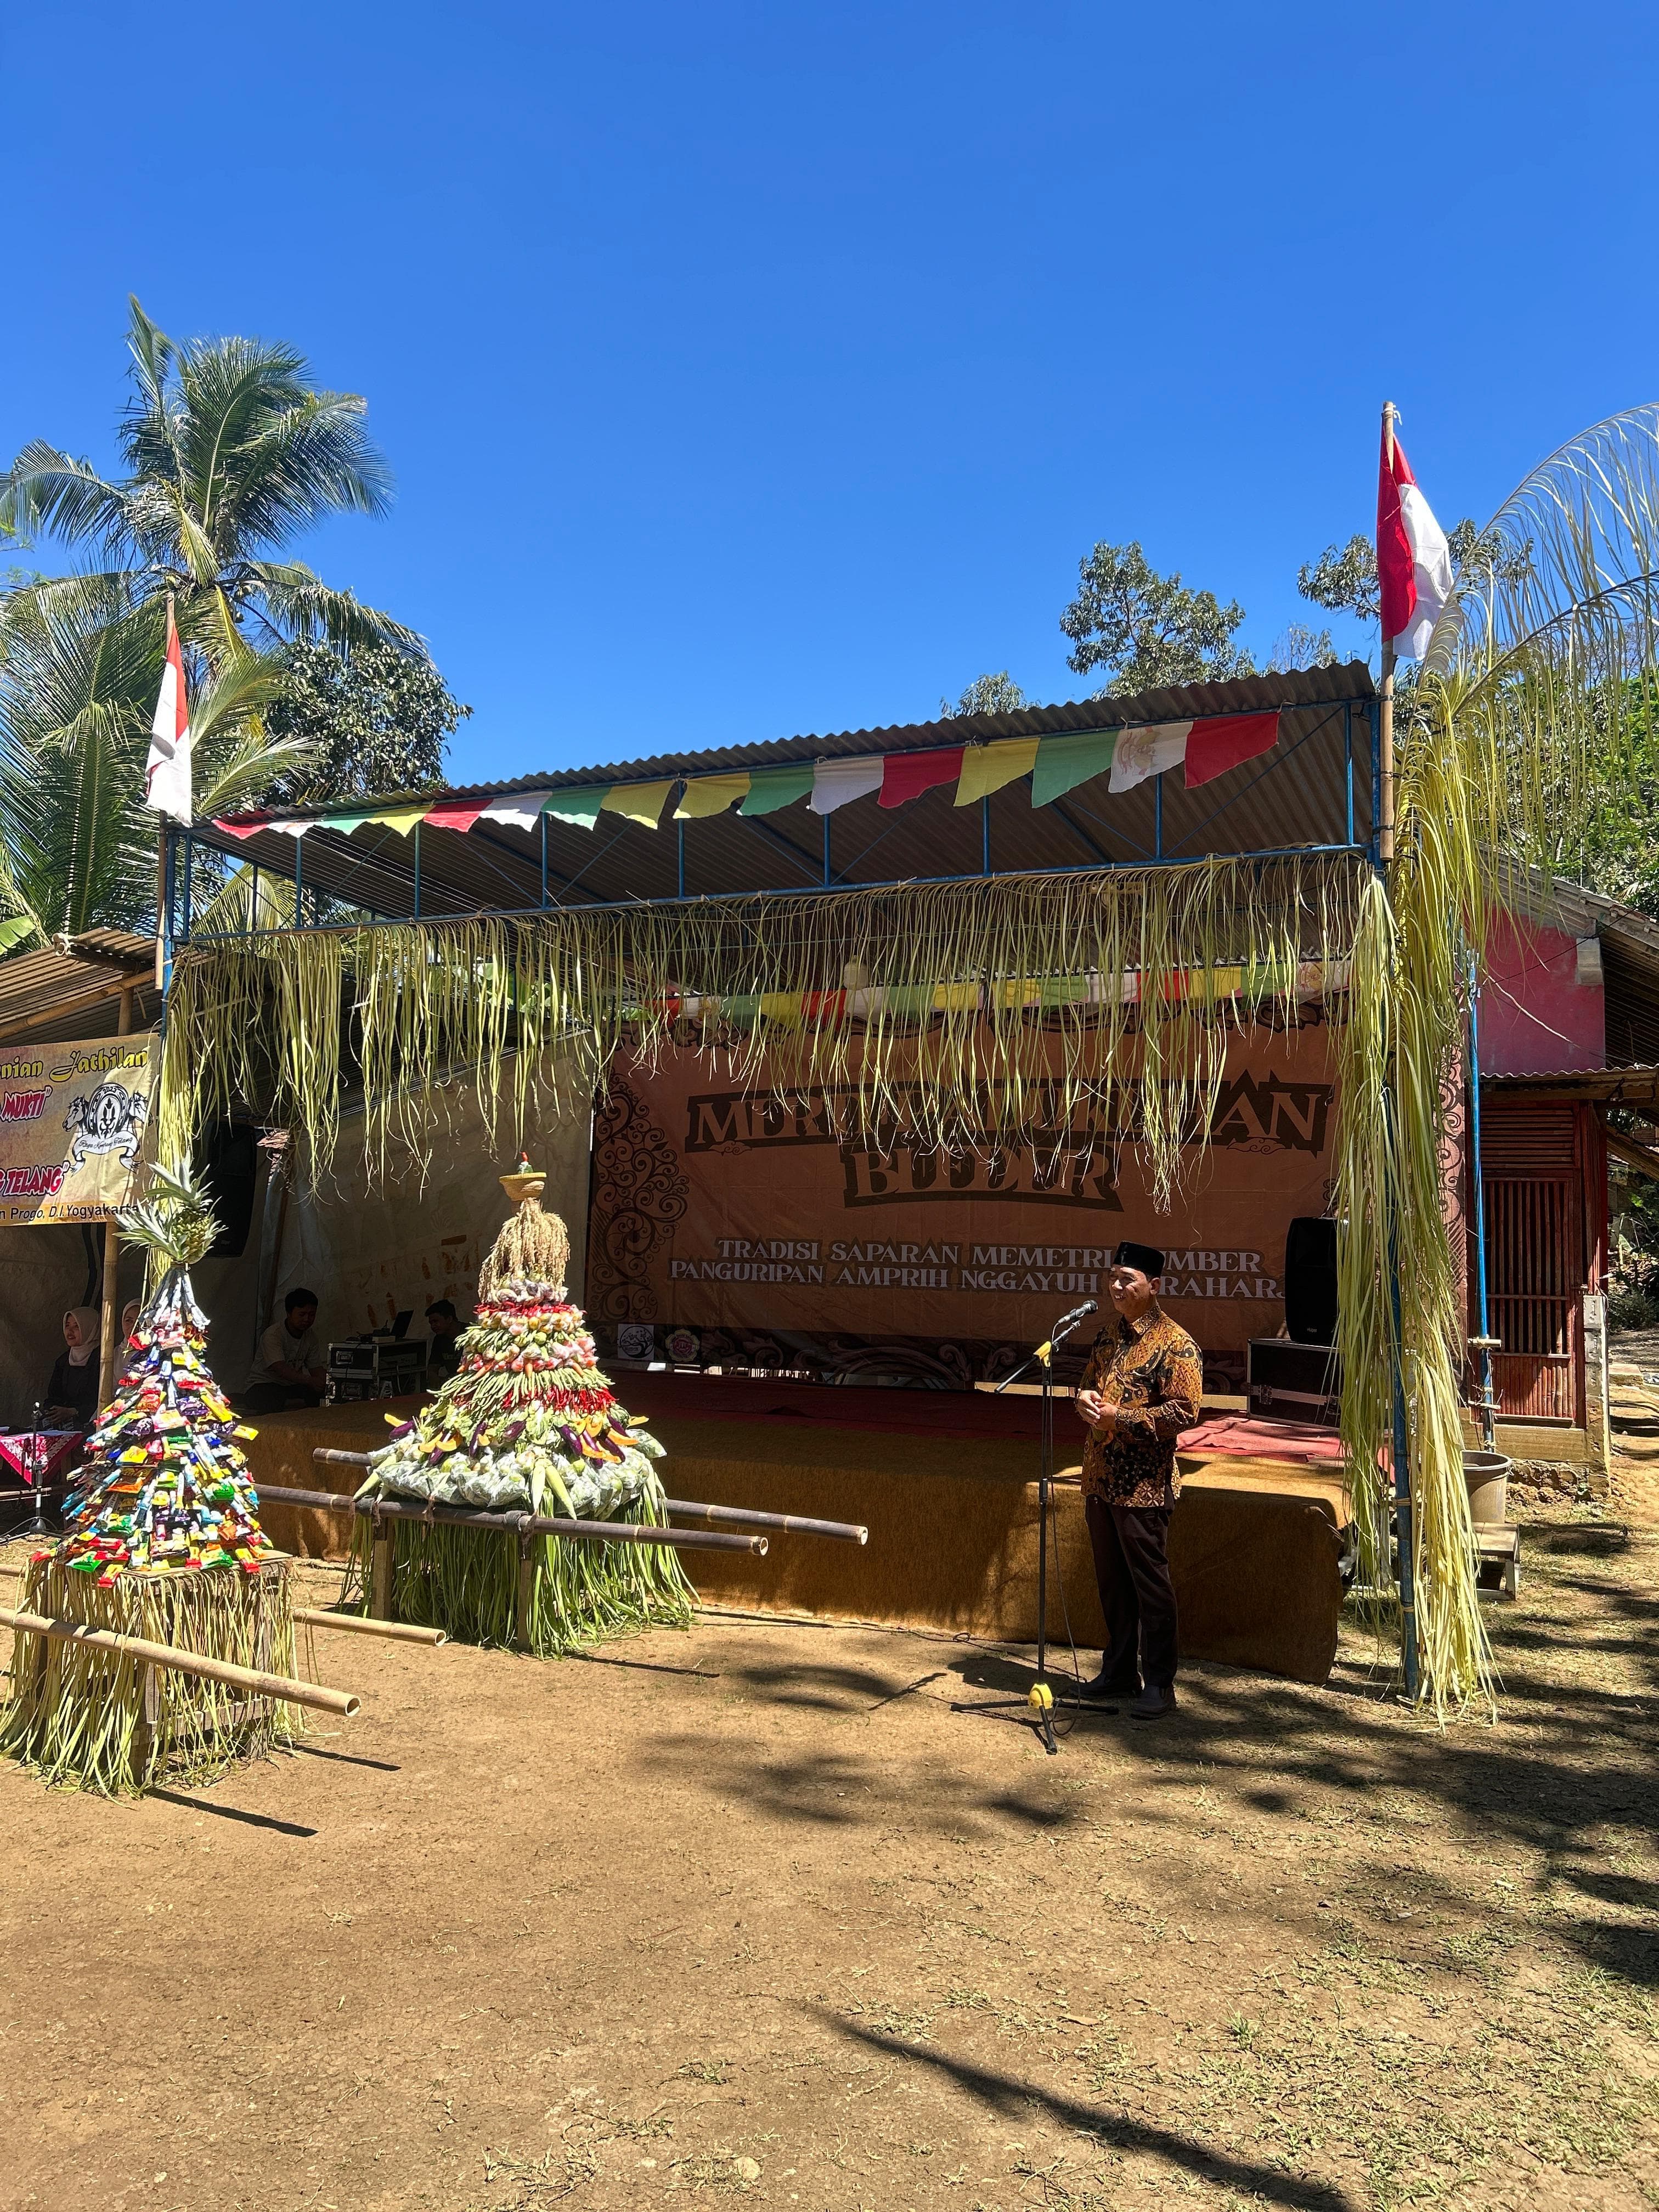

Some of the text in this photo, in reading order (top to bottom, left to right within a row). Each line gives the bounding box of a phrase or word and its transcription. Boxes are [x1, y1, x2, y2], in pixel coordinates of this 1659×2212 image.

[49, 1046, 148, 1082] Jathilan
[11, 1207, 44, 1221] Progo,
[718, 1240, 1261, 1273] TRADISI SAPARAN MEMETRI MBER
[671, 1261, 823, 1283] PANGURIPAN
[836, 1266, 949, 1288] AMPRIH
[961, 1269, 1098, 1294] NGGAYUH
